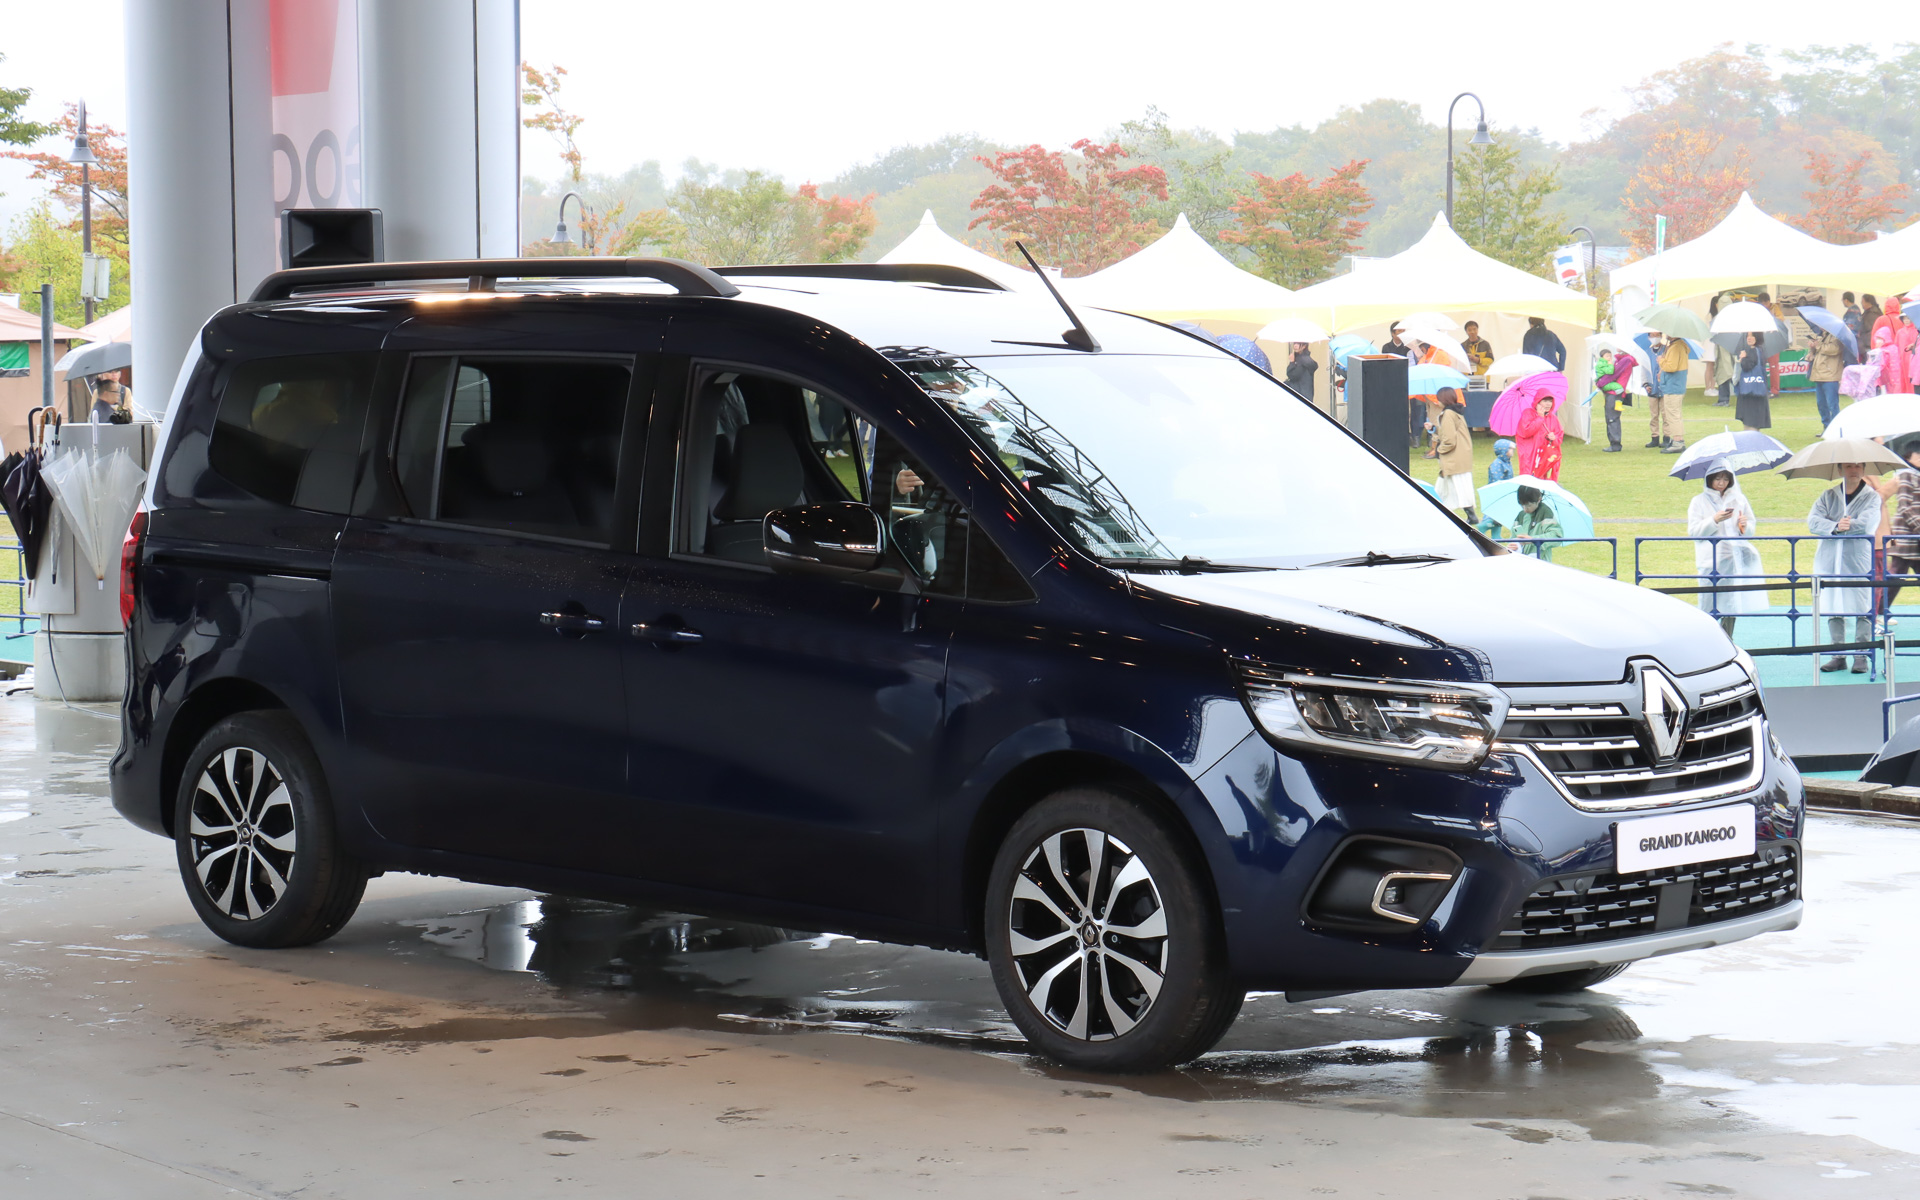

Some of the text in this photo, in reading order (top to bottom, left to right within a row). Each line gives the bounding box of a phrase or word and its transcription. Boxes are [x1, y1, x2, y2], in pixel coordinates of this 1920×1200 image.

[1778, 362, 1810, 374] astrol
[1639, 825, 1736, 852] GRAND KANGOO
